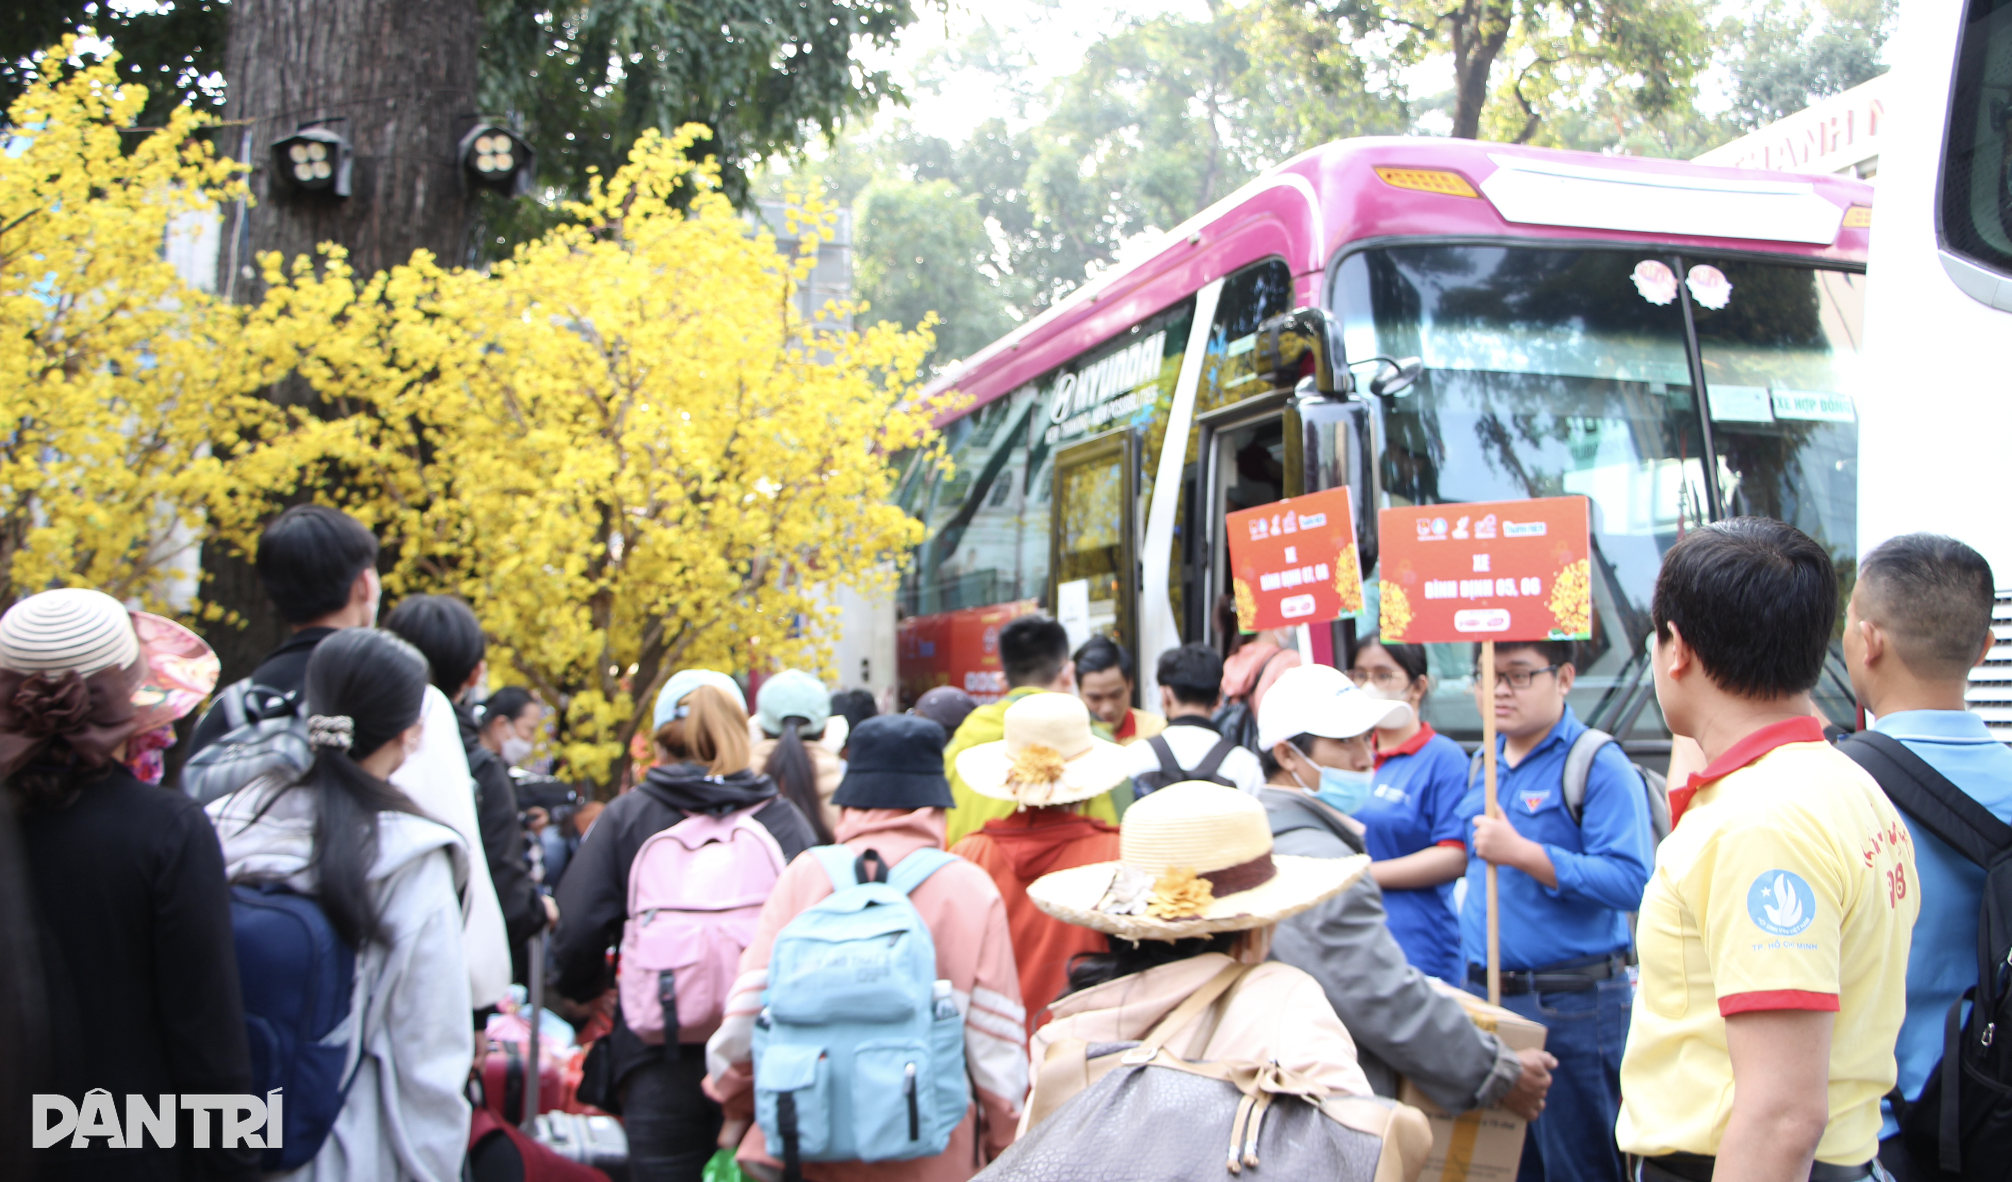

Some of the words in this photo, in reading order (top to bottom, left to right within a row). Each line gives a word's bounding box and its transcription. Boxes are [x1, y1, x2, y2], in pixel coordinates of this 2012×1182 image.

[1073, 330, 1167, 413] HYUNDAI
[1473, 554, 1490, 572] XE
[1424, 578, 1458, 599] BÌNH
[1460, 578, 1494, 600] ĐỊNH
[1796, 942, 1818, 950] MINH
